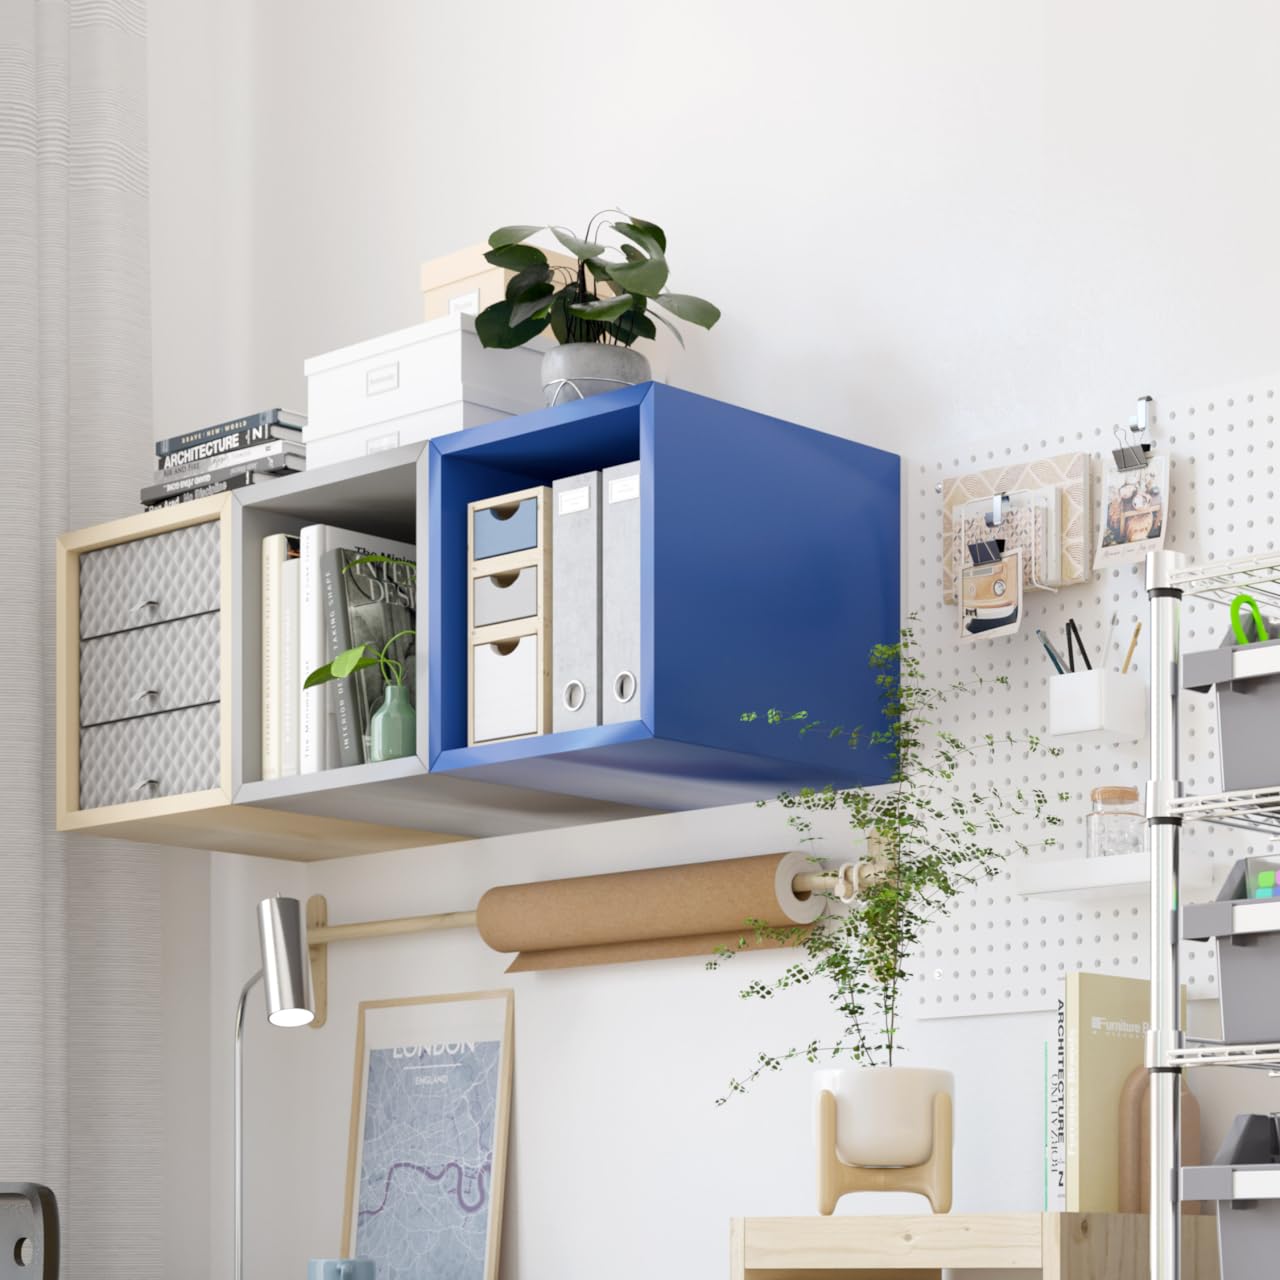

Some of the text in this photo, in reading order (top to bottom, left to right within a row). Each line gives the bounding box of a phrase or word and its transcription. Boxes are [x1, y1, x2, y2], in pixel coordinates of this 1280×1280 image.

[163, 432, 240, 470] ARCHITECTURE
[181, 419, 247, 444] BRAVE NEW WORLD
[325, 572, 334, 606] SHAPE
[329, 610, 338, 650] TAKING
[339, 698, 350, 750] INTERIOR
[1057, 998, 1065, 1143] ARCHITECTURE
